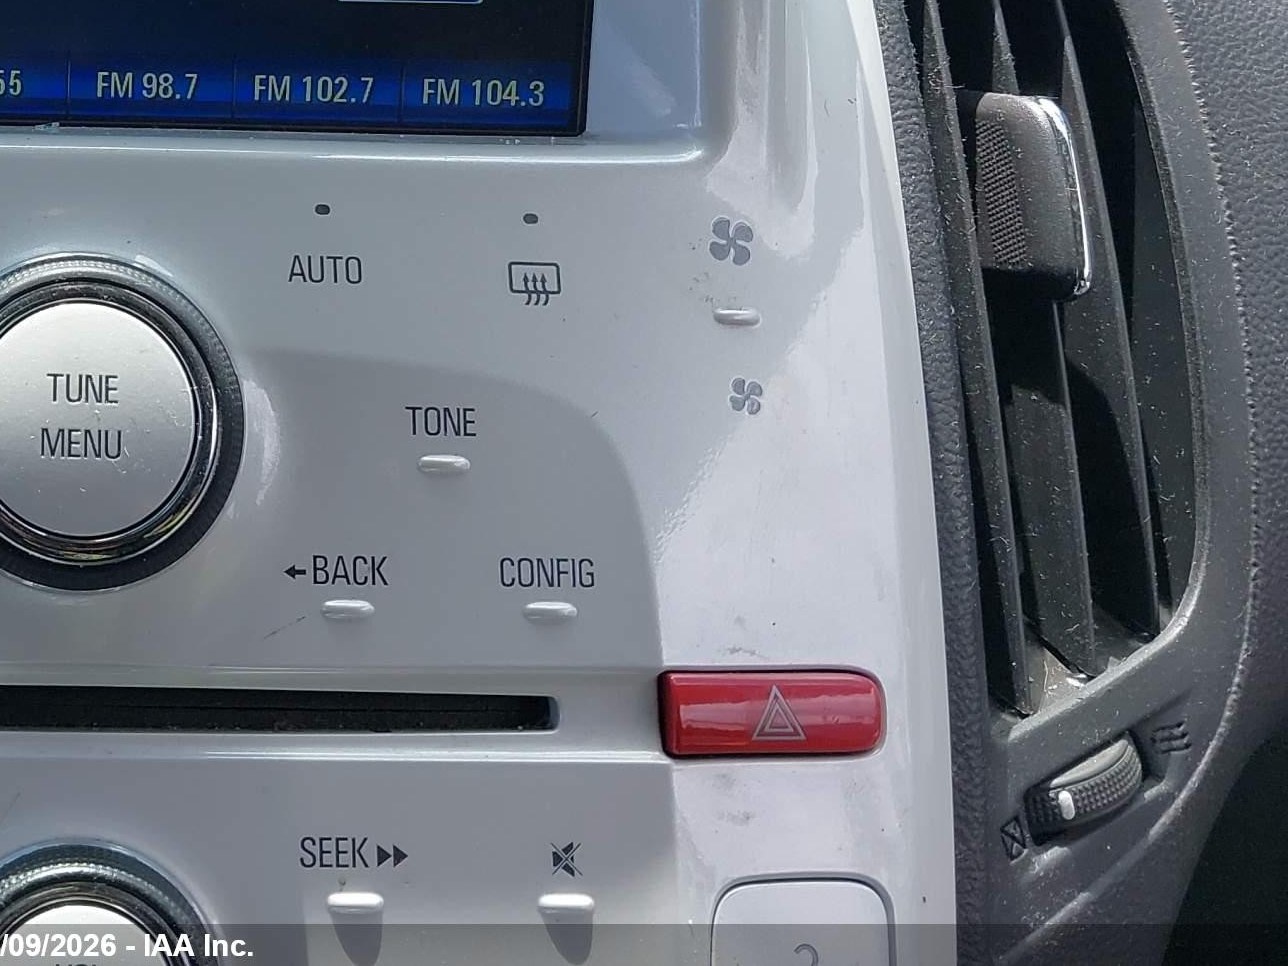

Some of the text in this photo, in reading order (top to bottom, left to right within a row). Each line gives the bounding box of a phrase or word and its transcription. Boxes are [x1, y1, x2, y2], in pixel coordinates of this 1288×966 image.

[97, 71, 198, 99] FM 98.7
[254, 75, 374, 103] FM 102.7
[422, 78, 544, 107] FM 104.3
[288, 255, 362, 284] AUTO
[47, 373, 118, 404] TUNE
[406, 406, 476, 437] TONE
[40, 428, 122, 459] MENU
[313, 555, 388, 586] BACK
[499, 558, 595, 588] CONFIG
[299, 837, 369, 869] SEEK
